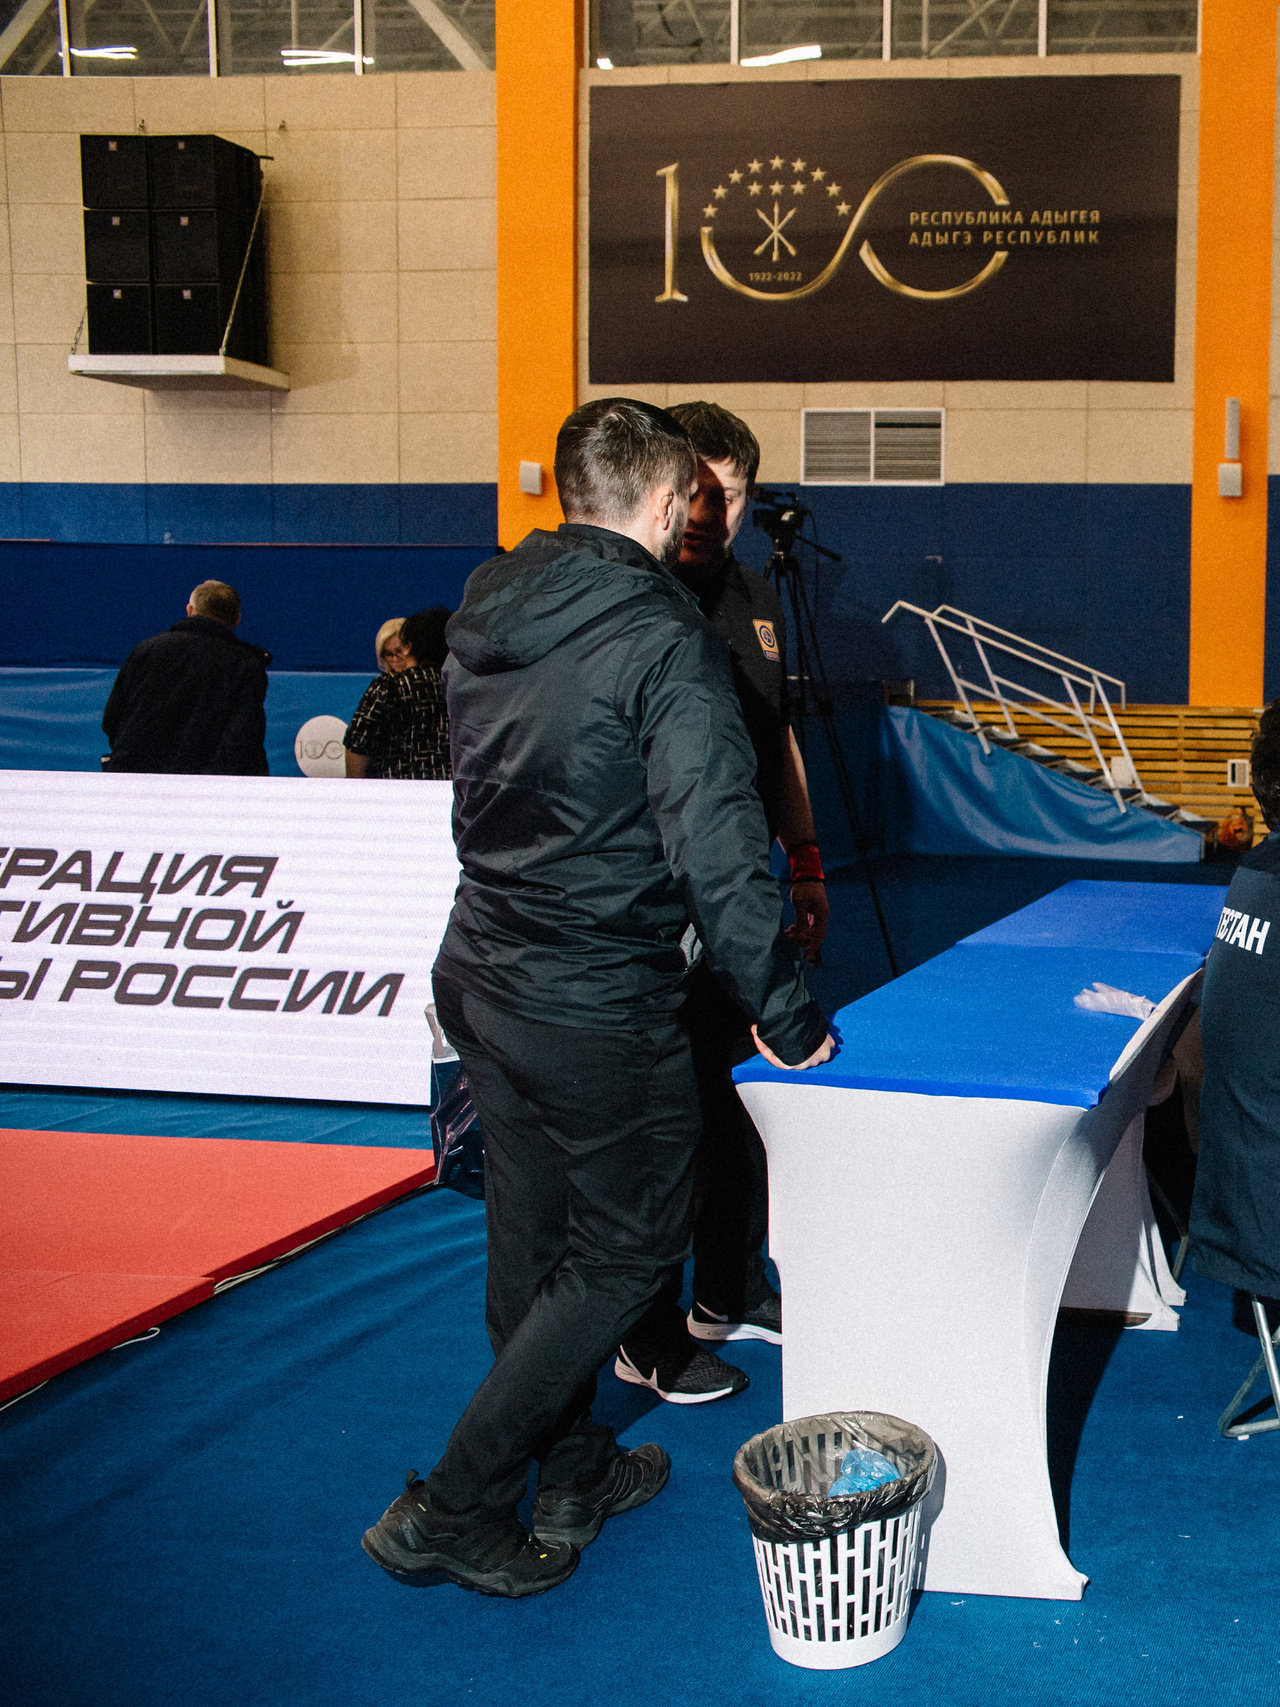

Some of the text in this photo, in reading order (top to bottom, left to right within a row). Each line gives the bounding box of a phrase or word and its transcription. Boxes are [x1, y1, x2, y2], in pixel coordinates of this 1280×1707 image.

[909, 209, 1100, 227] РЕСПУБЛИКА АДЫГЕЯ
[908, 230, 1100, 247] АДЫГЭ РЕСПУБЛИК
[748, 271, 803, 282] 1922-2022
[59, 959, 405, 1017] РОССИИ
